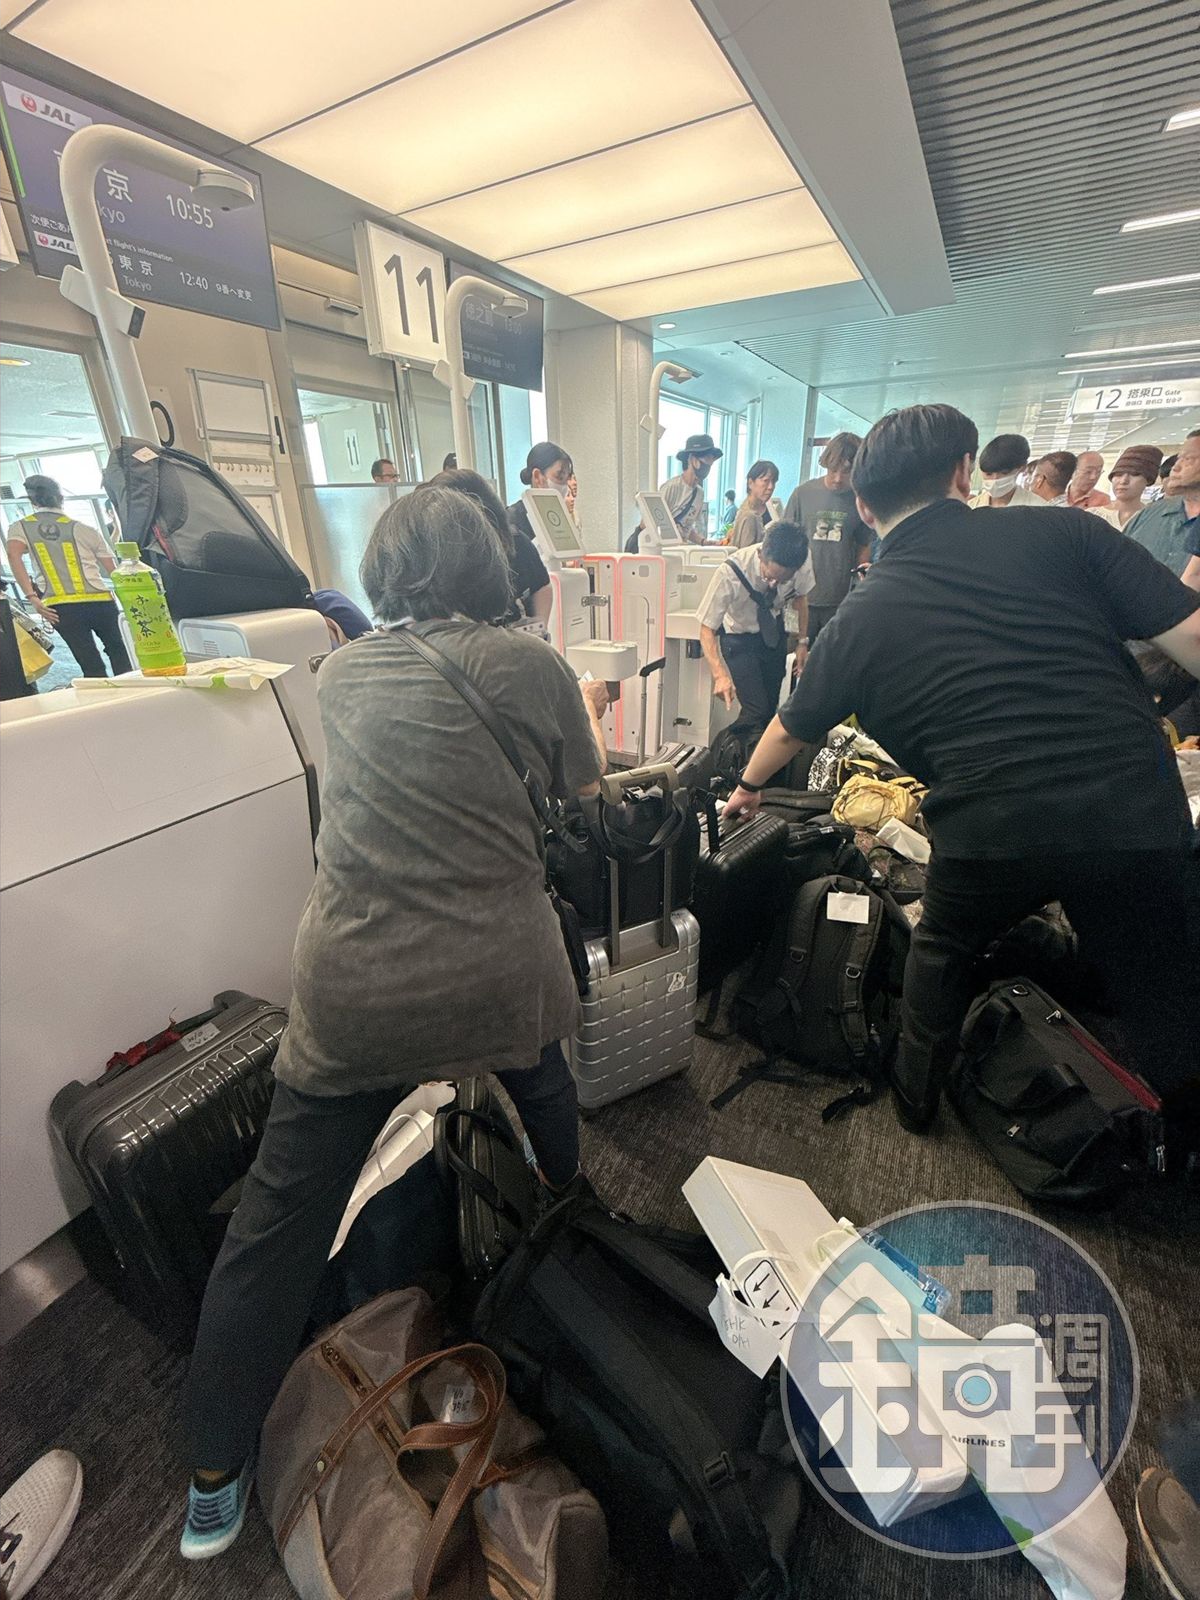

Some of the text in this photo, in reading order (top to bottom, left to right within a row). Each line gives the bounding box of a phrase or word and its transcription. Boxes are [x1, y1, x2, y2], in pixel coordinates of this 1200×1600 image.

[41, 104, 76, 127] JAL
[97, 199, 126, 224] kyo
[166, 194, 214, 229] 10:55
[50, 239, 74, 251] JAL
[138, 247, 174, 263] information
[122, 274, 152, 292] Tokyo
[180, 271, 208, 291] 12:40
[383, 253, 439, 344] 11
[1095, 388, 1122, 410] 12
[951, 1435, 1006, 1447] AIRLINES
